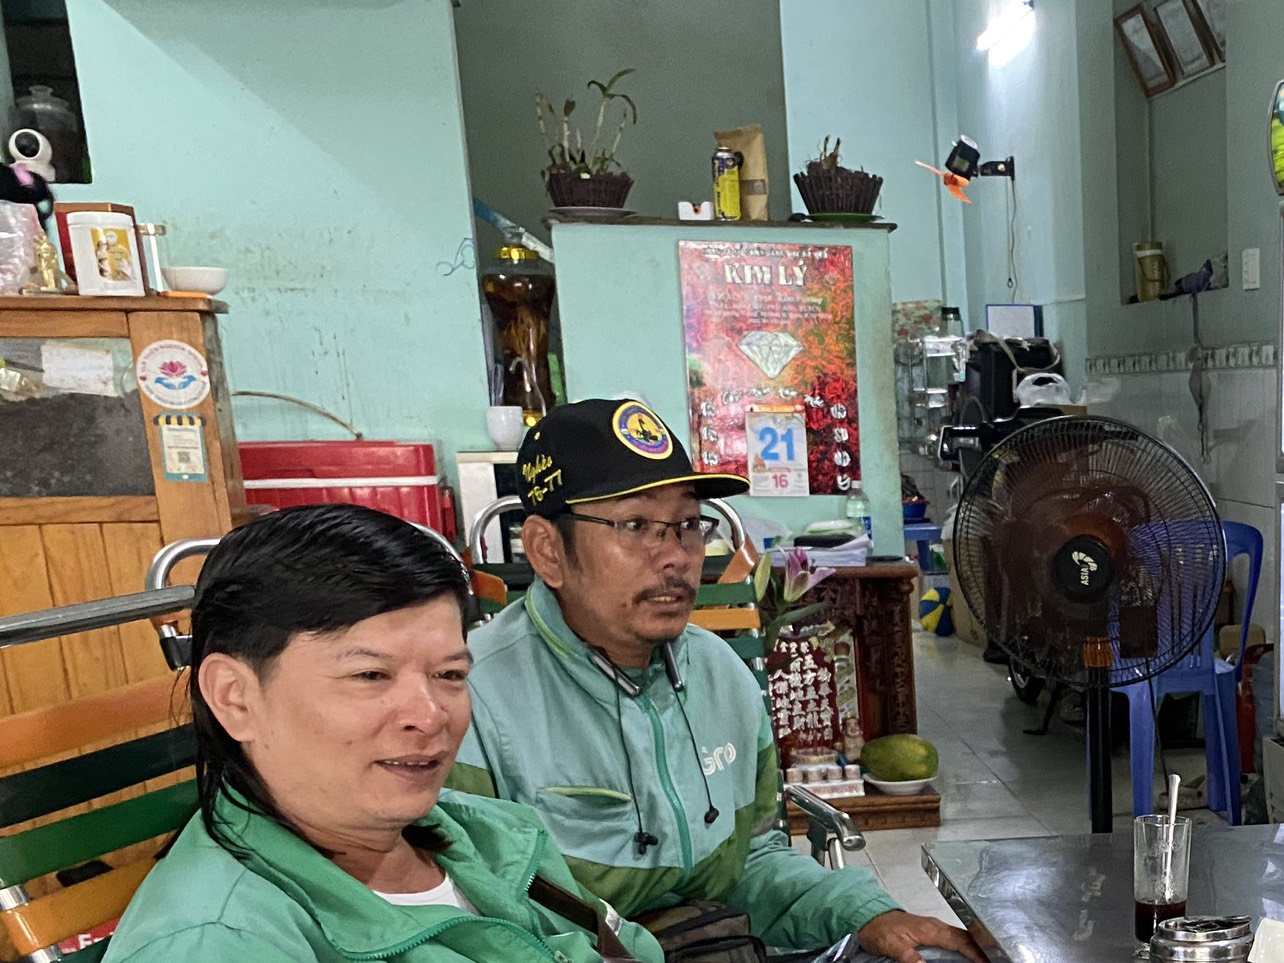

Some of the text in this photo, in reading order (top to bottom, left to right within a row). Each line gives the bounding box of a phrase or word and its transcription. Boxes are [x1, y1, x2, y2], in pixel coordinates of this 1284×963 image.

[724, 259, 808, 286] KIM LÝ
[759, 426, 796, 461] 21
[772, 474, 789, 489] 16
